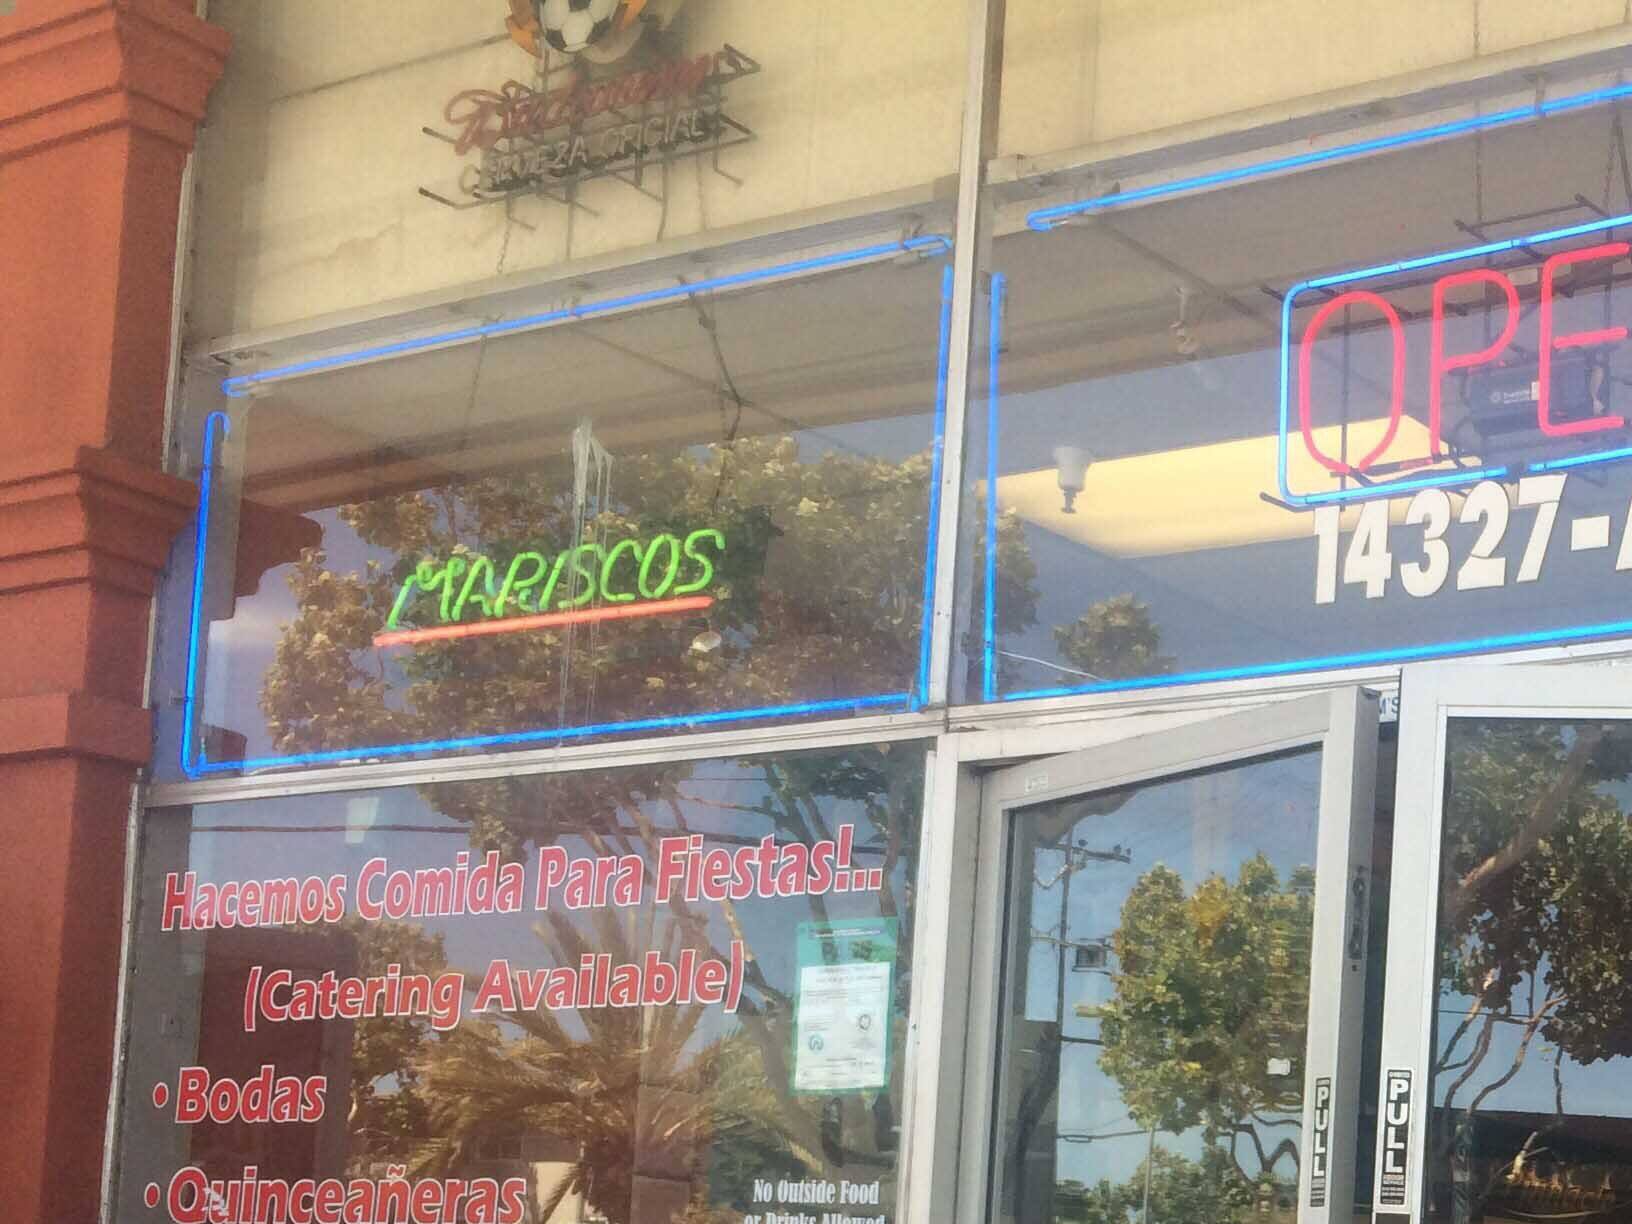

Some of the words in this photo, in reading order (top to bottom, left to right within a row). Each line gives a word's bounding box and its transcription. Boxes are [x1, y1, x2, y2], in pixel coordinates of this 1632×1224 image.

[386, 528, 725, 630] MARISCOS
[160, 870, 346, 932] Hacemos
[356, 849, 523, 920] Comida
[535, 844, 642, 912] Para
[243, 964, 464, 1033] (Catering
[470, 939, 747, 1013] Available)
[174, 1063, 328, 1125] Bodas
[1313, 1085, 1330, 1177] PULL
[1385, 1078, 1410, 1174] PULL
[753, 1179, 773, 1203] No
[777, 1178, 836, 1204] Outside
[839, 1180, 880, 1205] Food
